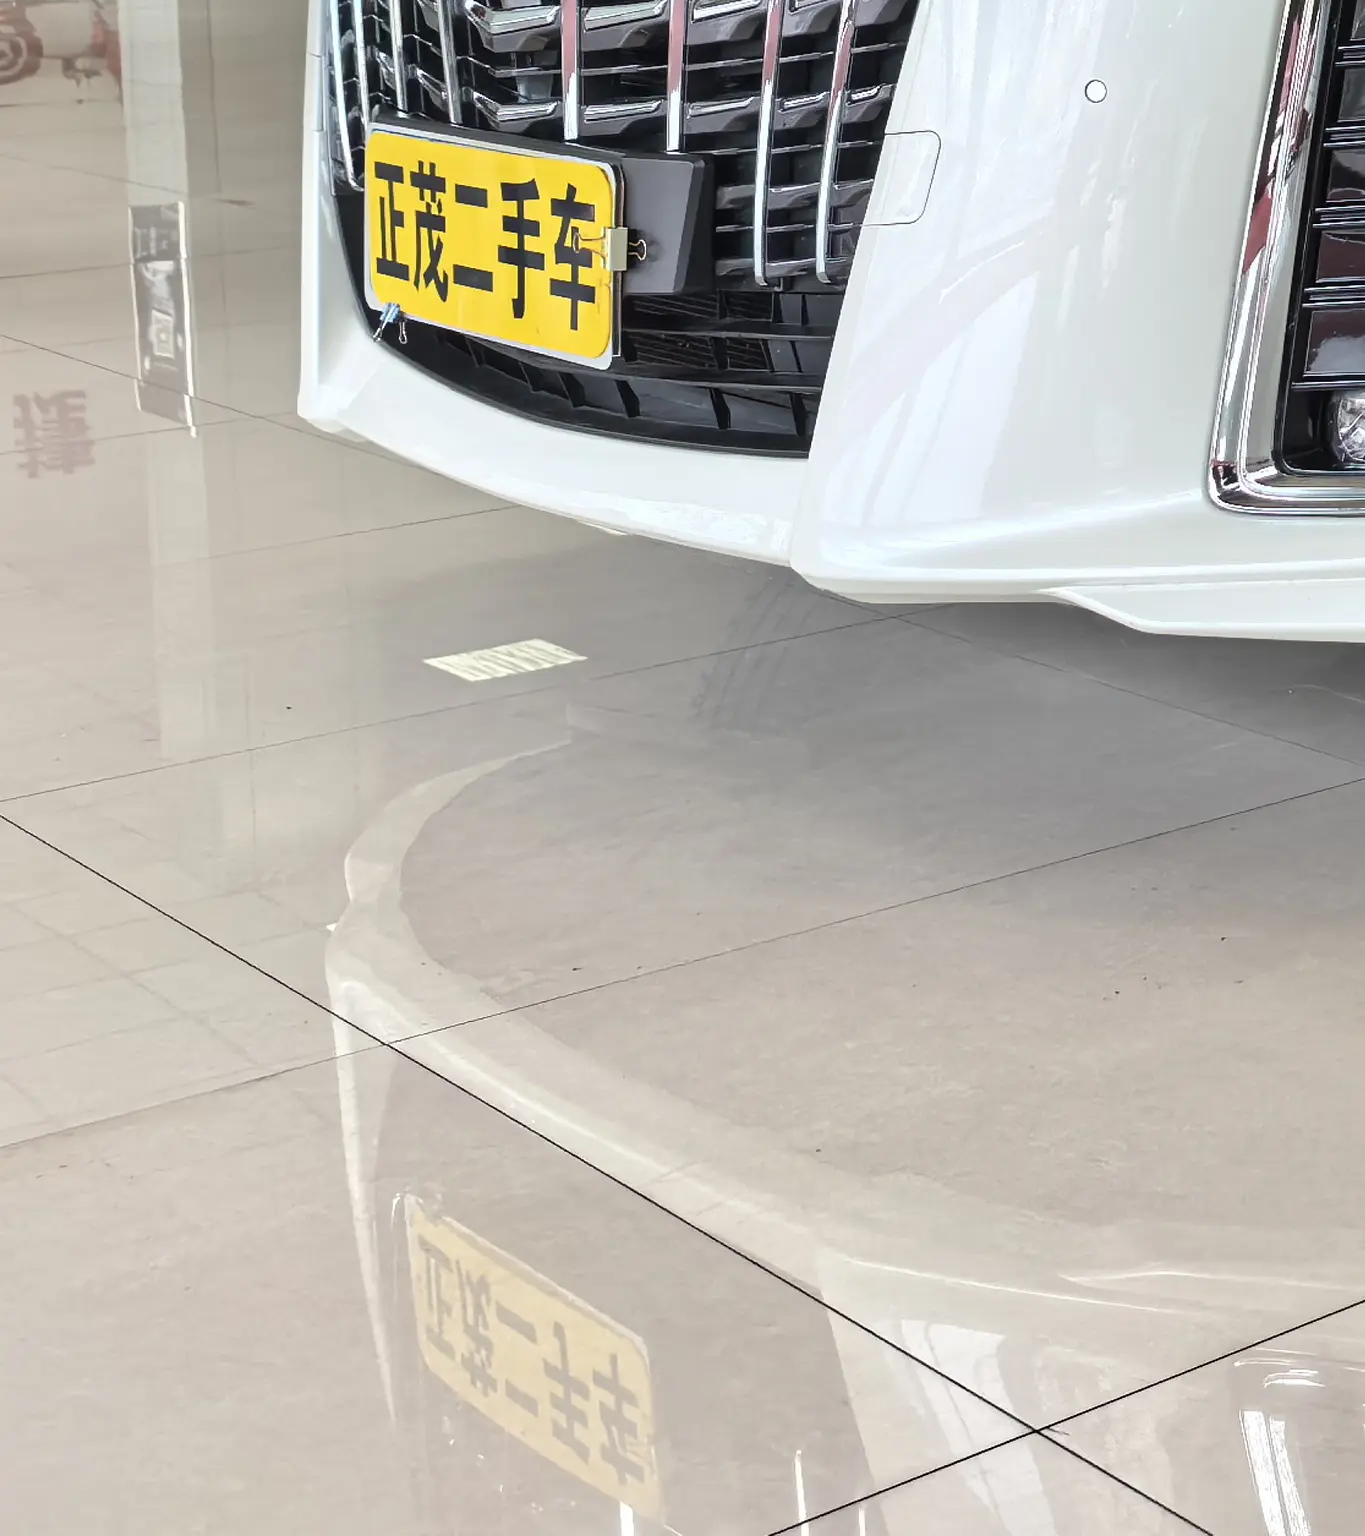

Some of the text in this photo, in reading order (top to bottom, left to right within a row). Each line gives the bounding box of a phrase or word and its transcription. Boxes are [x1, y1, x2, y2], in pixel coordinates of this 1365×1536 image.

[375, 161, 596, 331] 正茂二手车
